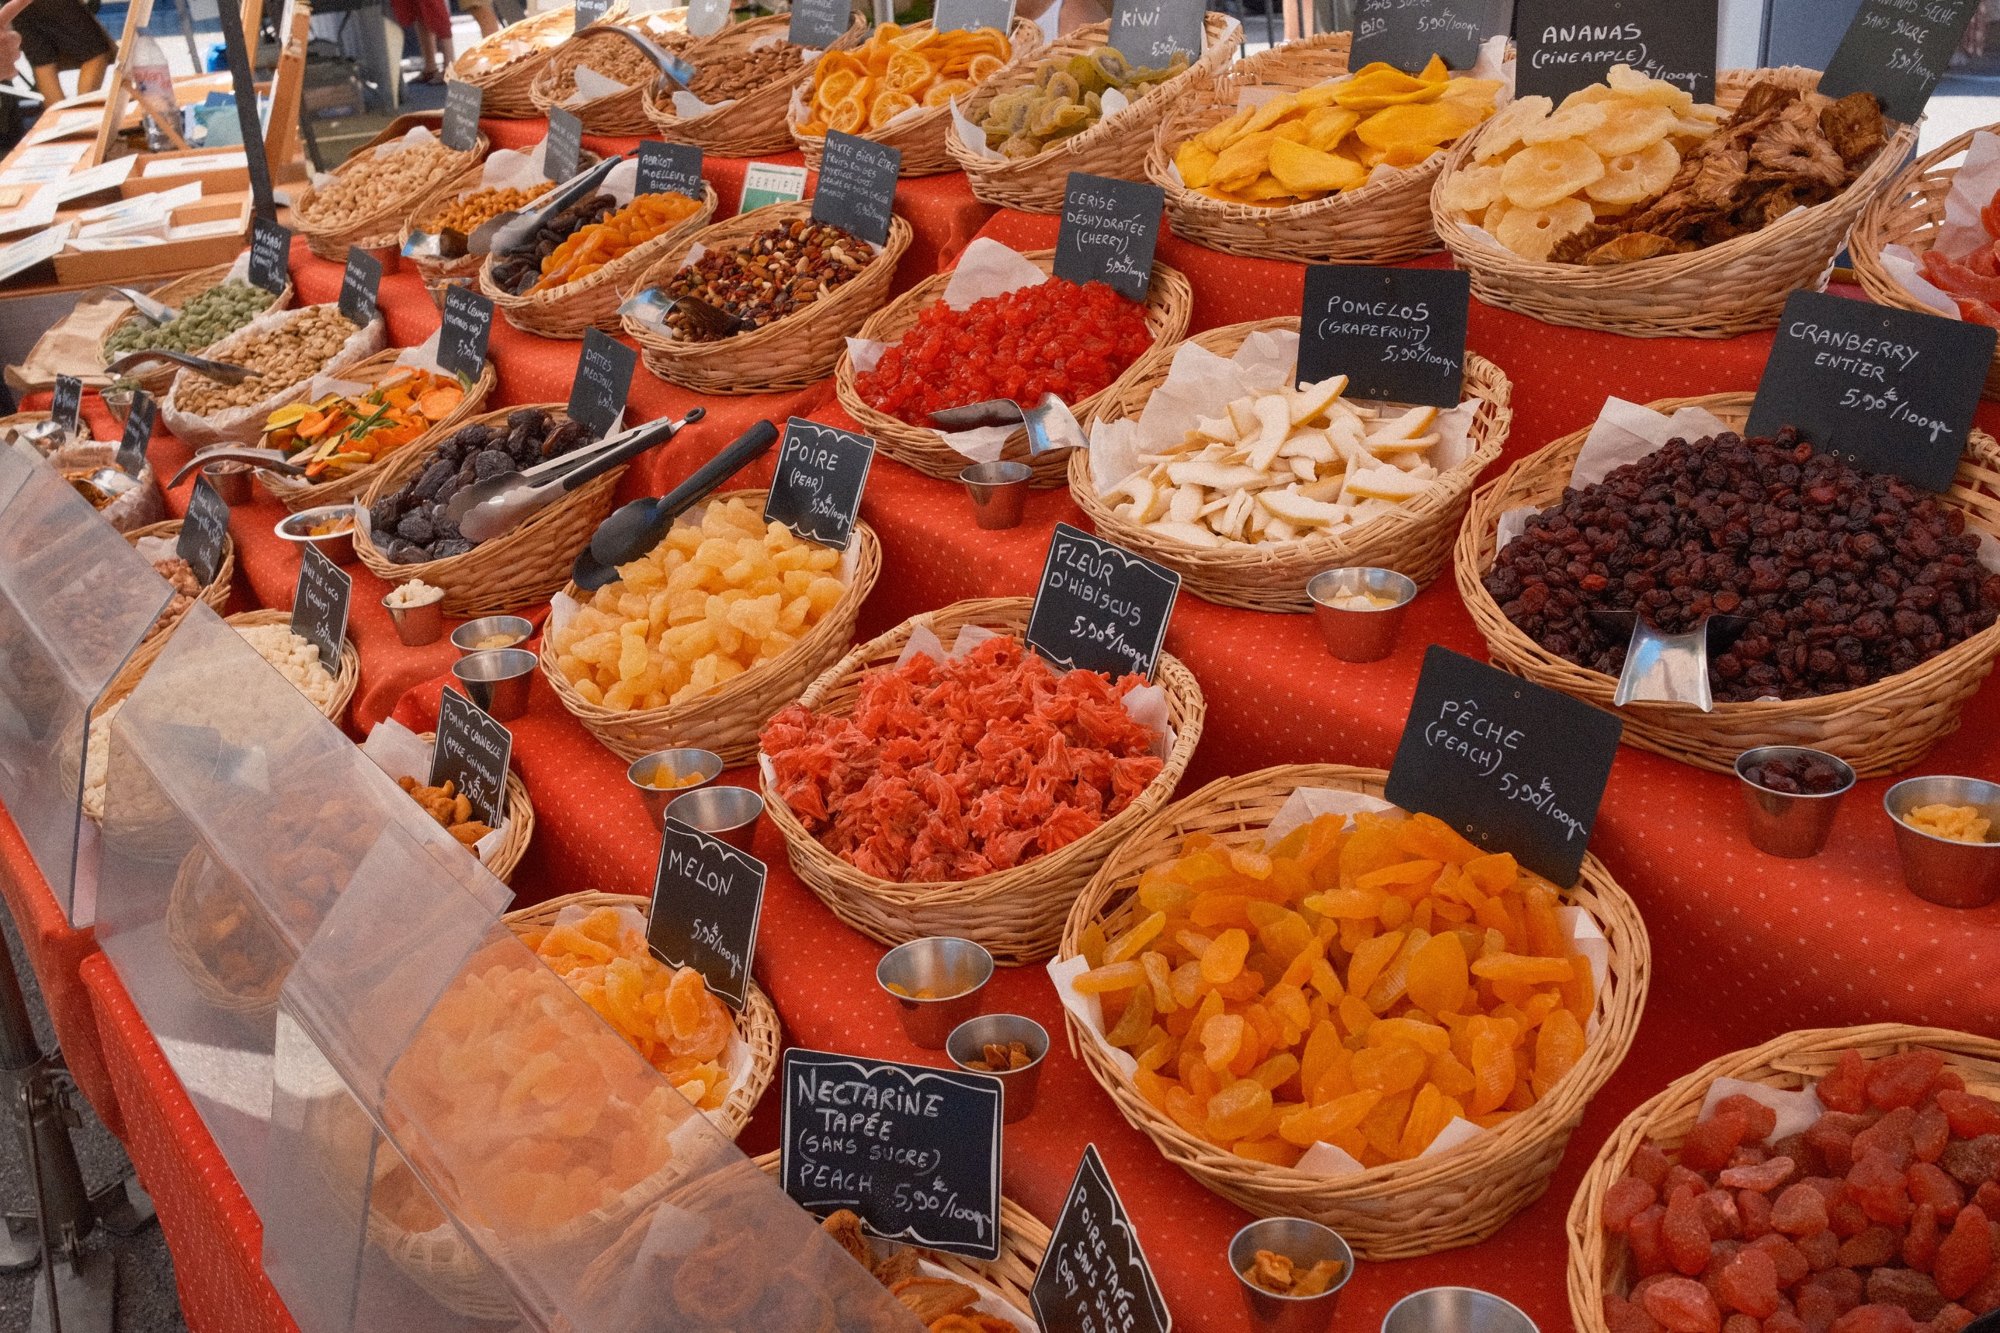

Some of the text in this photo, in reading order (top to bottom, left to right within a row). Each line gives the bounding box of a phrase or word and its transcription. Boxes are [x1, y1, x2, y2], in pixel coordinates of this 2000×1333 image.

[1541, 22, 1642, 44] ANANAS
[1068, 190, 1118, 211] CERISE
[1075, 228, 1130, 256] (CHERRY)
[1327, 295, 1430, 322] POMELOS
[1318, 317, 1431, 347] (GRAPEFRUIT)
[1789, 321, 1921, 372] CRANBERRY
[586, 348, 613, 372] DATTES
[784, 435, 840, 472] POIRE
[789, 466, 824, 497] (PEAR)
[1056, 542, 1115, 587] FLEUR
[1048, 569, 1142, 627] D'HIBISCUS
[444, 703, 503, 761] POMME CANNELLE
[1439, 698, 1526, 750] PÊCHE
[1424, 720, 1503, 777] (PEACH)
[668, 848, 735, 897] MELON
[797, 1066, 945, 1118] NECTARINE
[814, 1106, 894, 1142] TAPÉE
[798, 1127, 942, 1177] (SANS SUCRE)
[799, 1162, 873, 1194] PEACH
[1074, 1240, 1098, 1288] SANS
